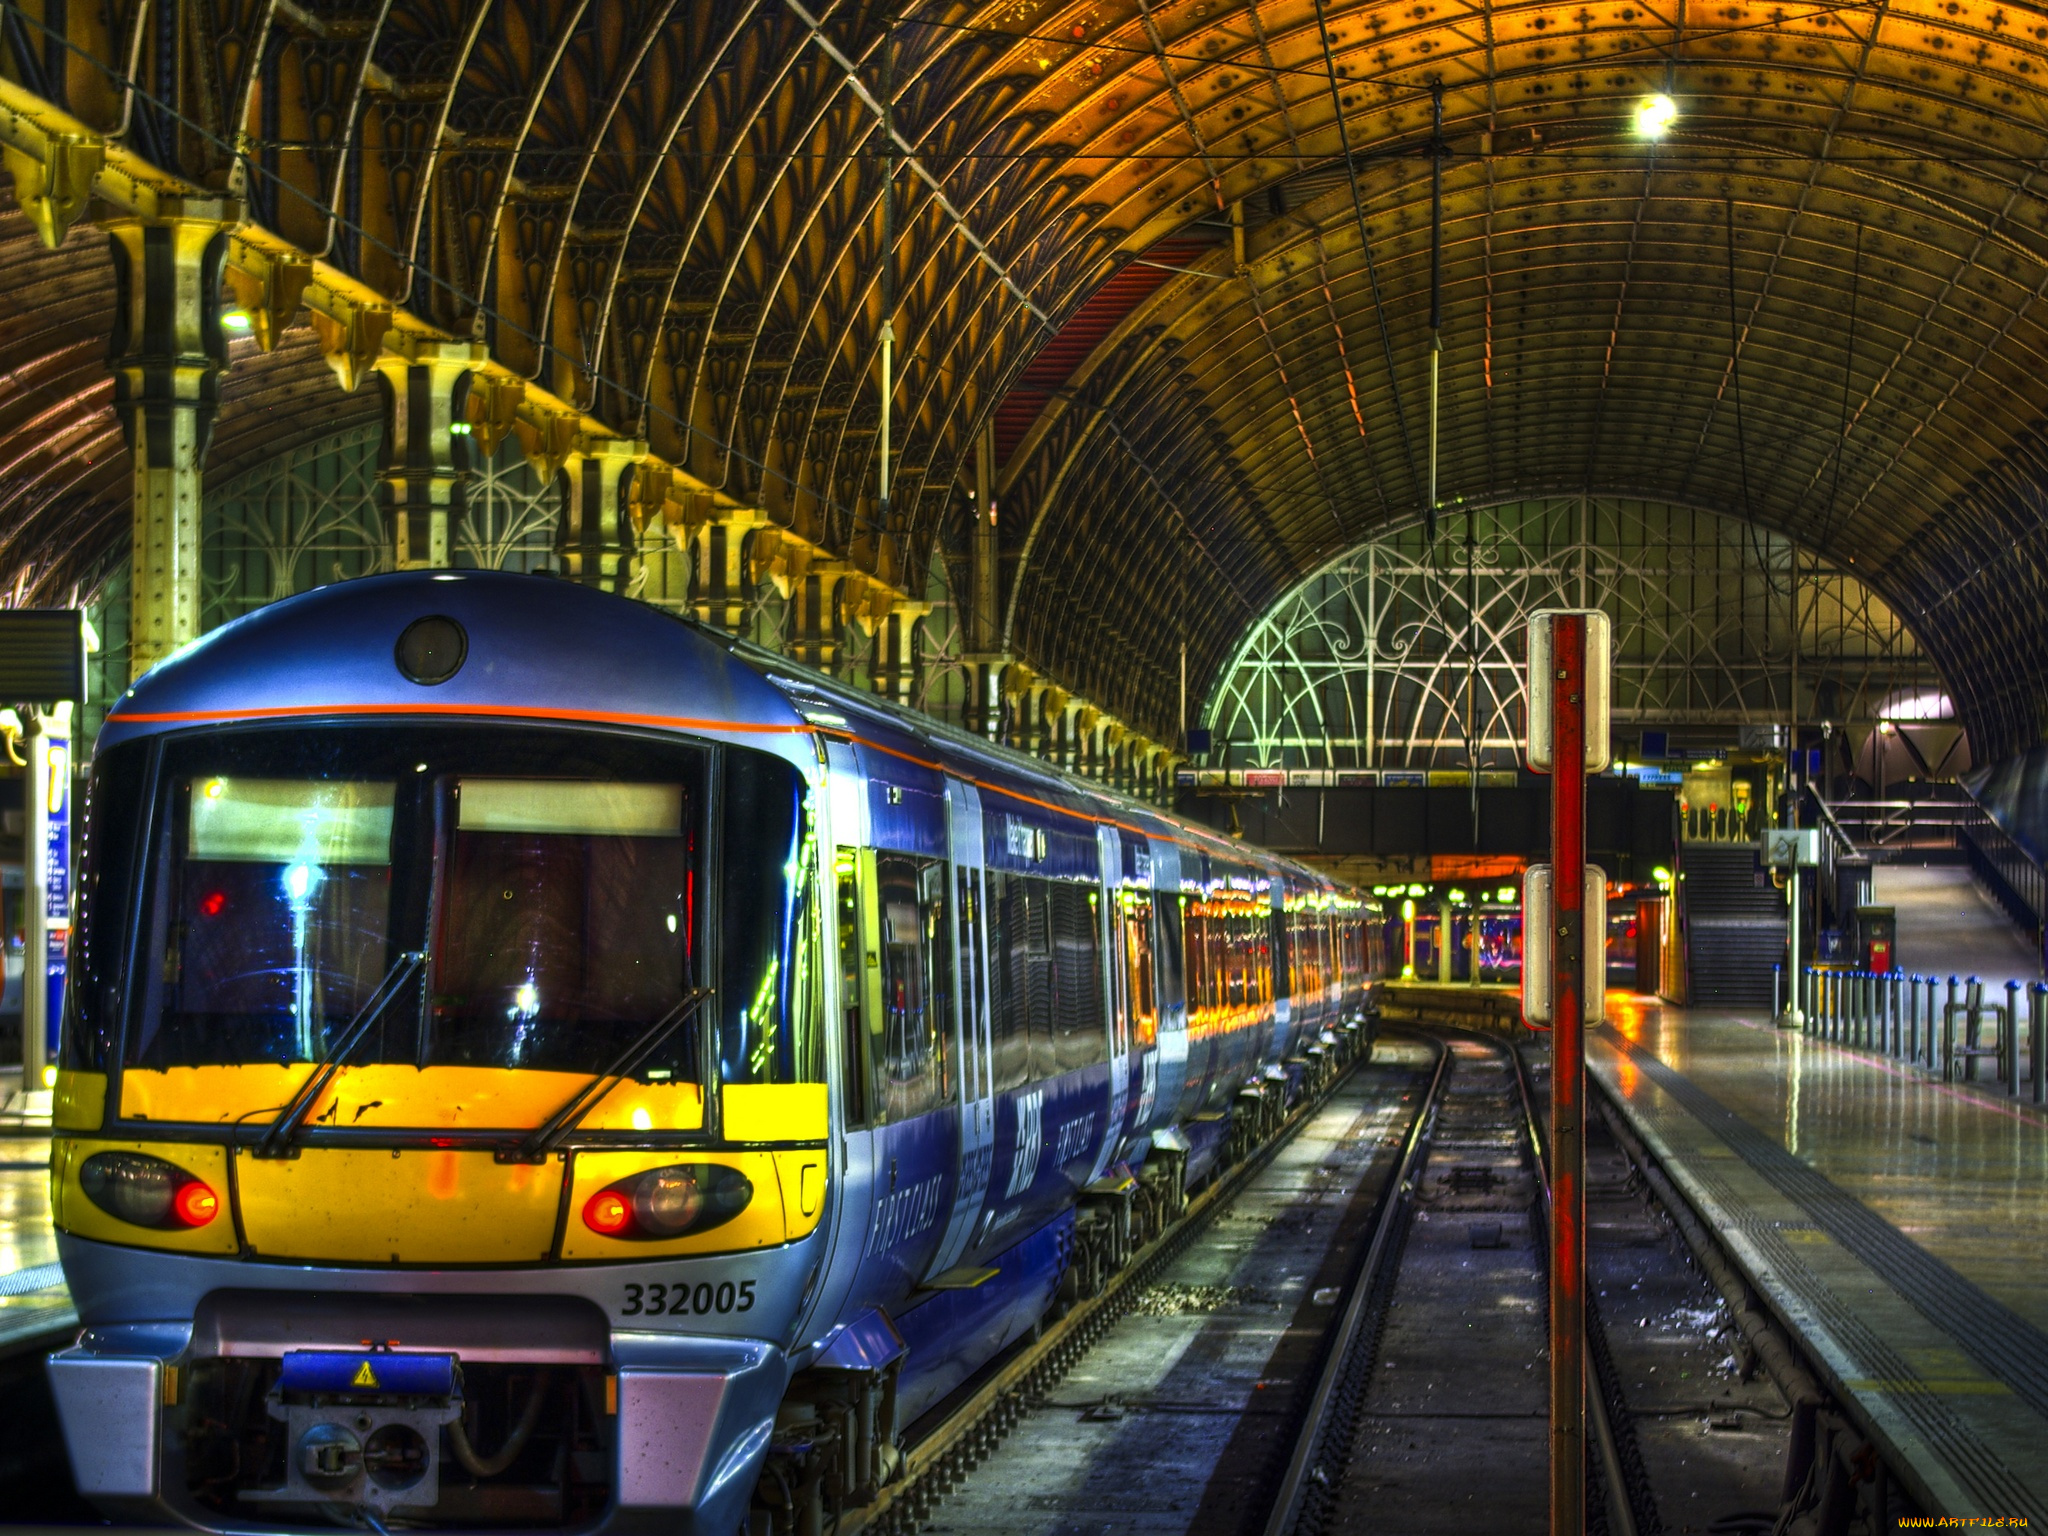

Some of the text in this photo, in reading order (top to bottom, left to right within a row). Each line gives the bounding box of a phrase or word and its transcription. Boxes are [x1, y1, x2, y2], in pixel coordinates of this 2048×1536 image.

[867, 1173, 943, 1261] FIRST CLASS
[621, 1280, 757, 1316] 332005
